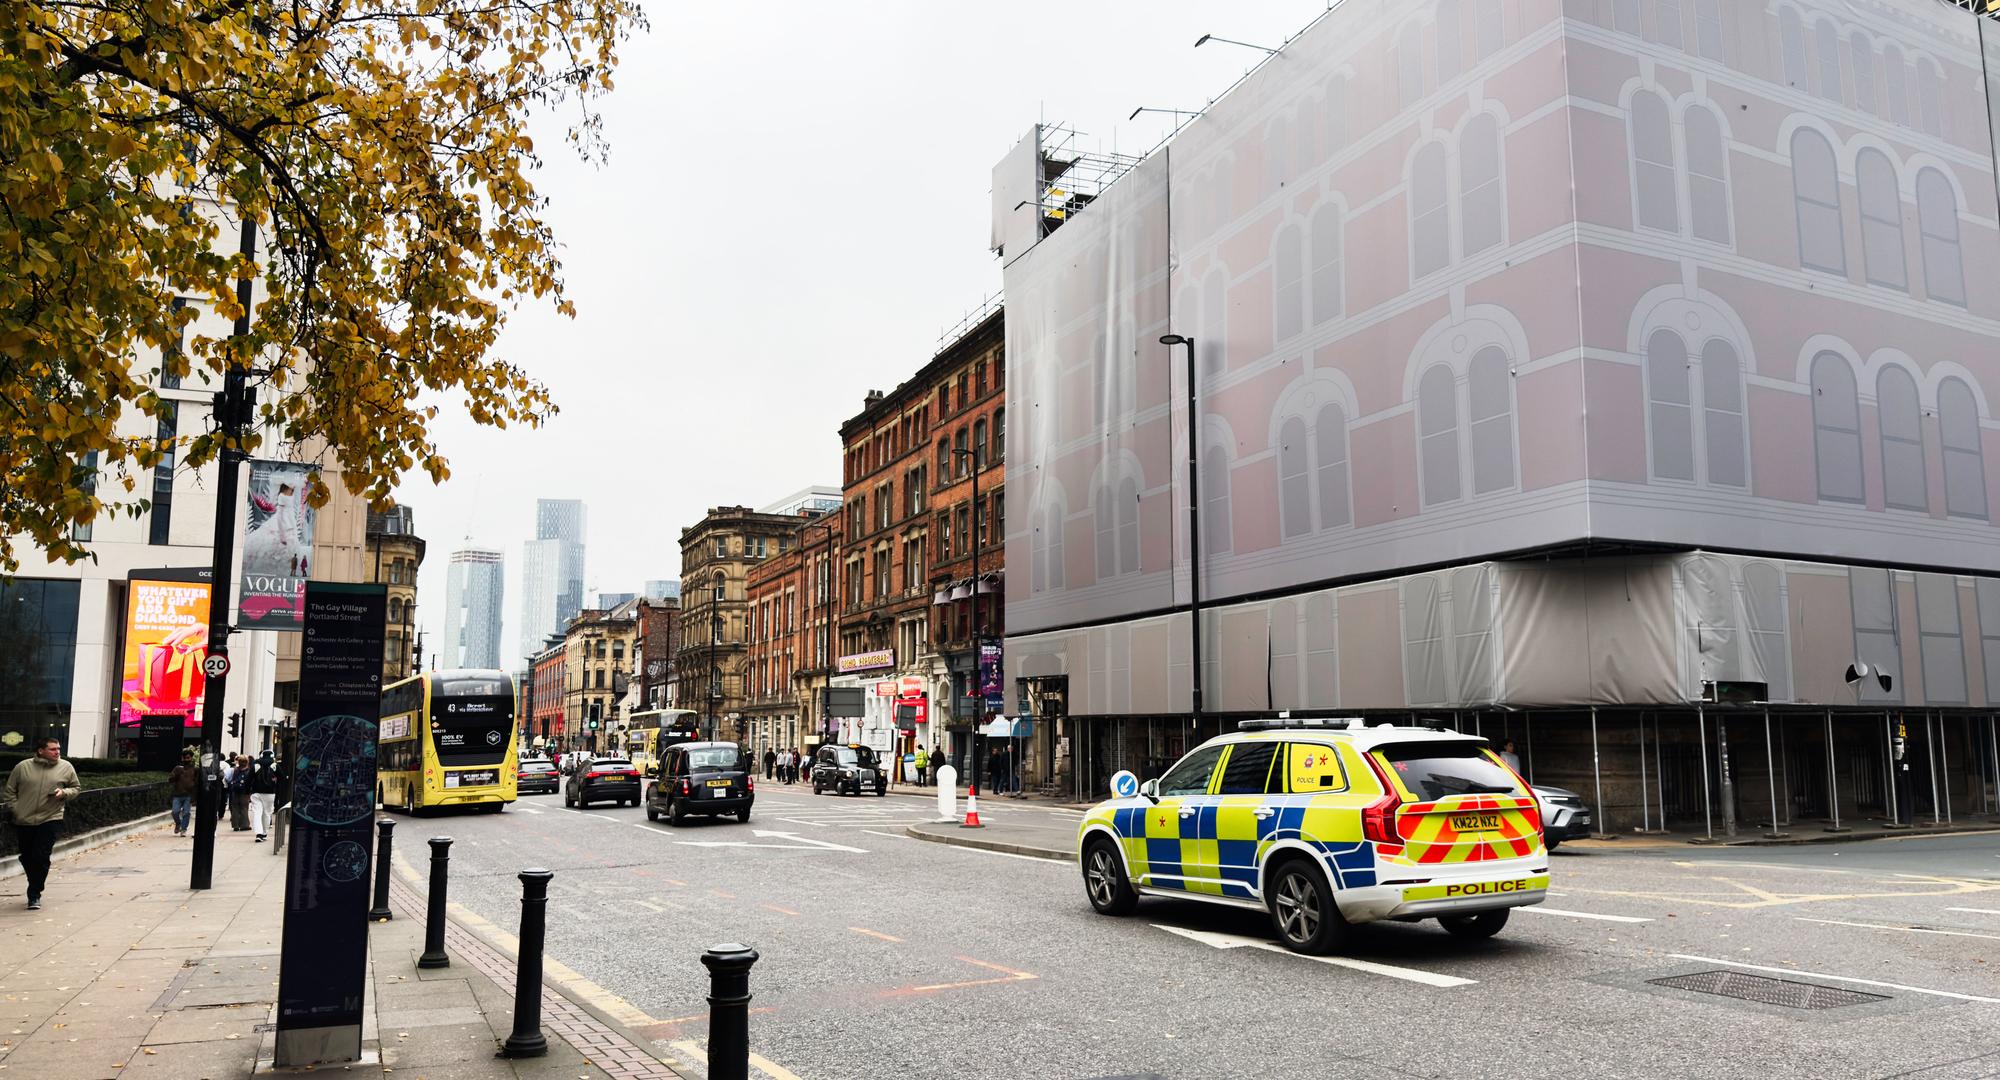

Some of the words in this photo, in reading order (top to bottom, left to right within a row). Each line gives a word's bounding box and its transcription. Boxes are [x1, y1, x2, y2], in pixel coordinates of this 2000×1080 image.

[246, 576, 305, 593] VOGUE
[138, 586, 208, 598] WHATEVER
[138, 596, 164, 605] YOU
[168, 596, 195, 607] GIFT
[136, 604, 164, 614] ADD
[168, 605, 176, 614] A
[311, 603, 325, 611] The
[326, 604, 340, 613] Gay
[342, 604, 368, 613] Village
[136, 614, 196, 624] DIAMOND
[207, 660, 226, 670] 20
[447, 704, 456, 712] 43
[1453, 816, 1479, 829] KM22
[1480, 816, 1499, 827] NXZ
[1447, 880, 1526, 896] POLICE
